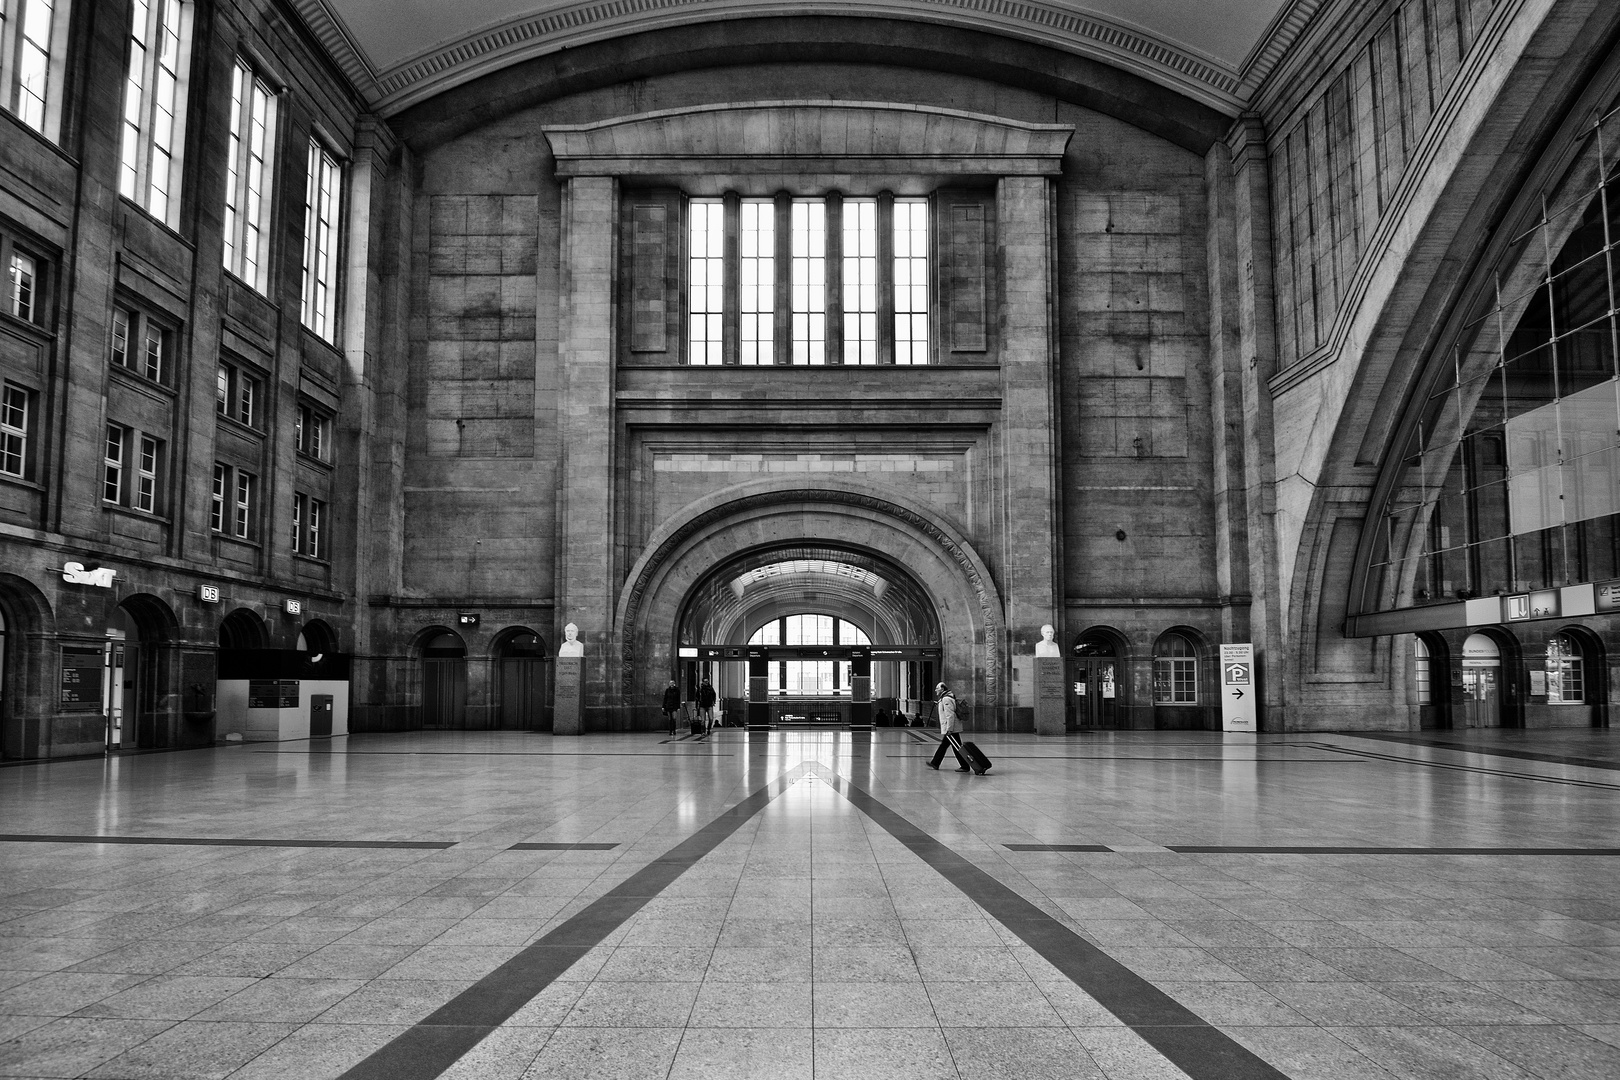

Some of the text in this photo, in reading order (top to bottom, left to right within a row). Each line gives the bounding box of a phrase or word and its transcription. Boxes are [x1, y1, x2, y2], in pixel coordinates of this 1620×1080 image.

[205, 588, 217, 600] DB
[290, 602, 299, 612] DB
[1232, 668, 1244, 681] P
